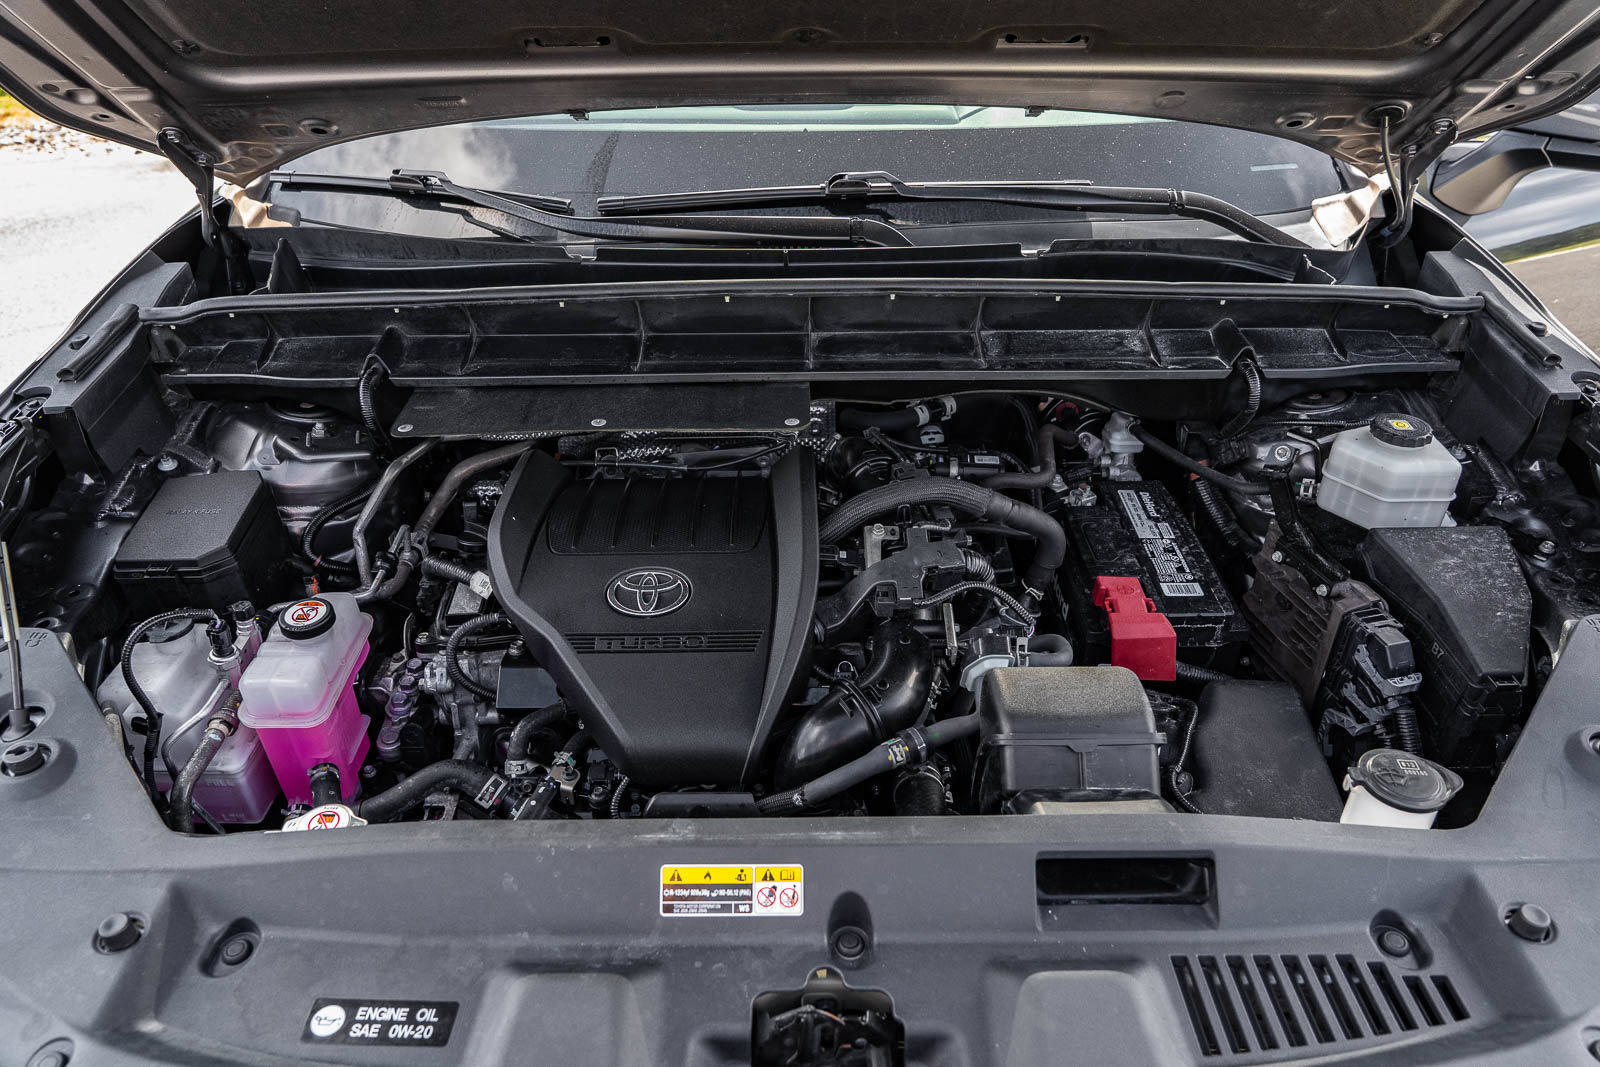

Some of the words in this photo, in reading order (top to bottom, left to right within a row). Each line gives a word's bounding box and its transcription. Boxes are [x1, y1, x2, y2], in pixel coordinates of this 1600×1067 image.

[1139, 490, 1160, 518] DieHard
[594, 636, 705, 651] TURBO
[1431, 641, 1445, 659] B7
[355, 1006, 409, 1021] ENGINE
[415, 1008, 439, 1022] OIL
[349, 1023, 381, 1038] SAE
[388, 1025, 434, 1039] 0W-20
